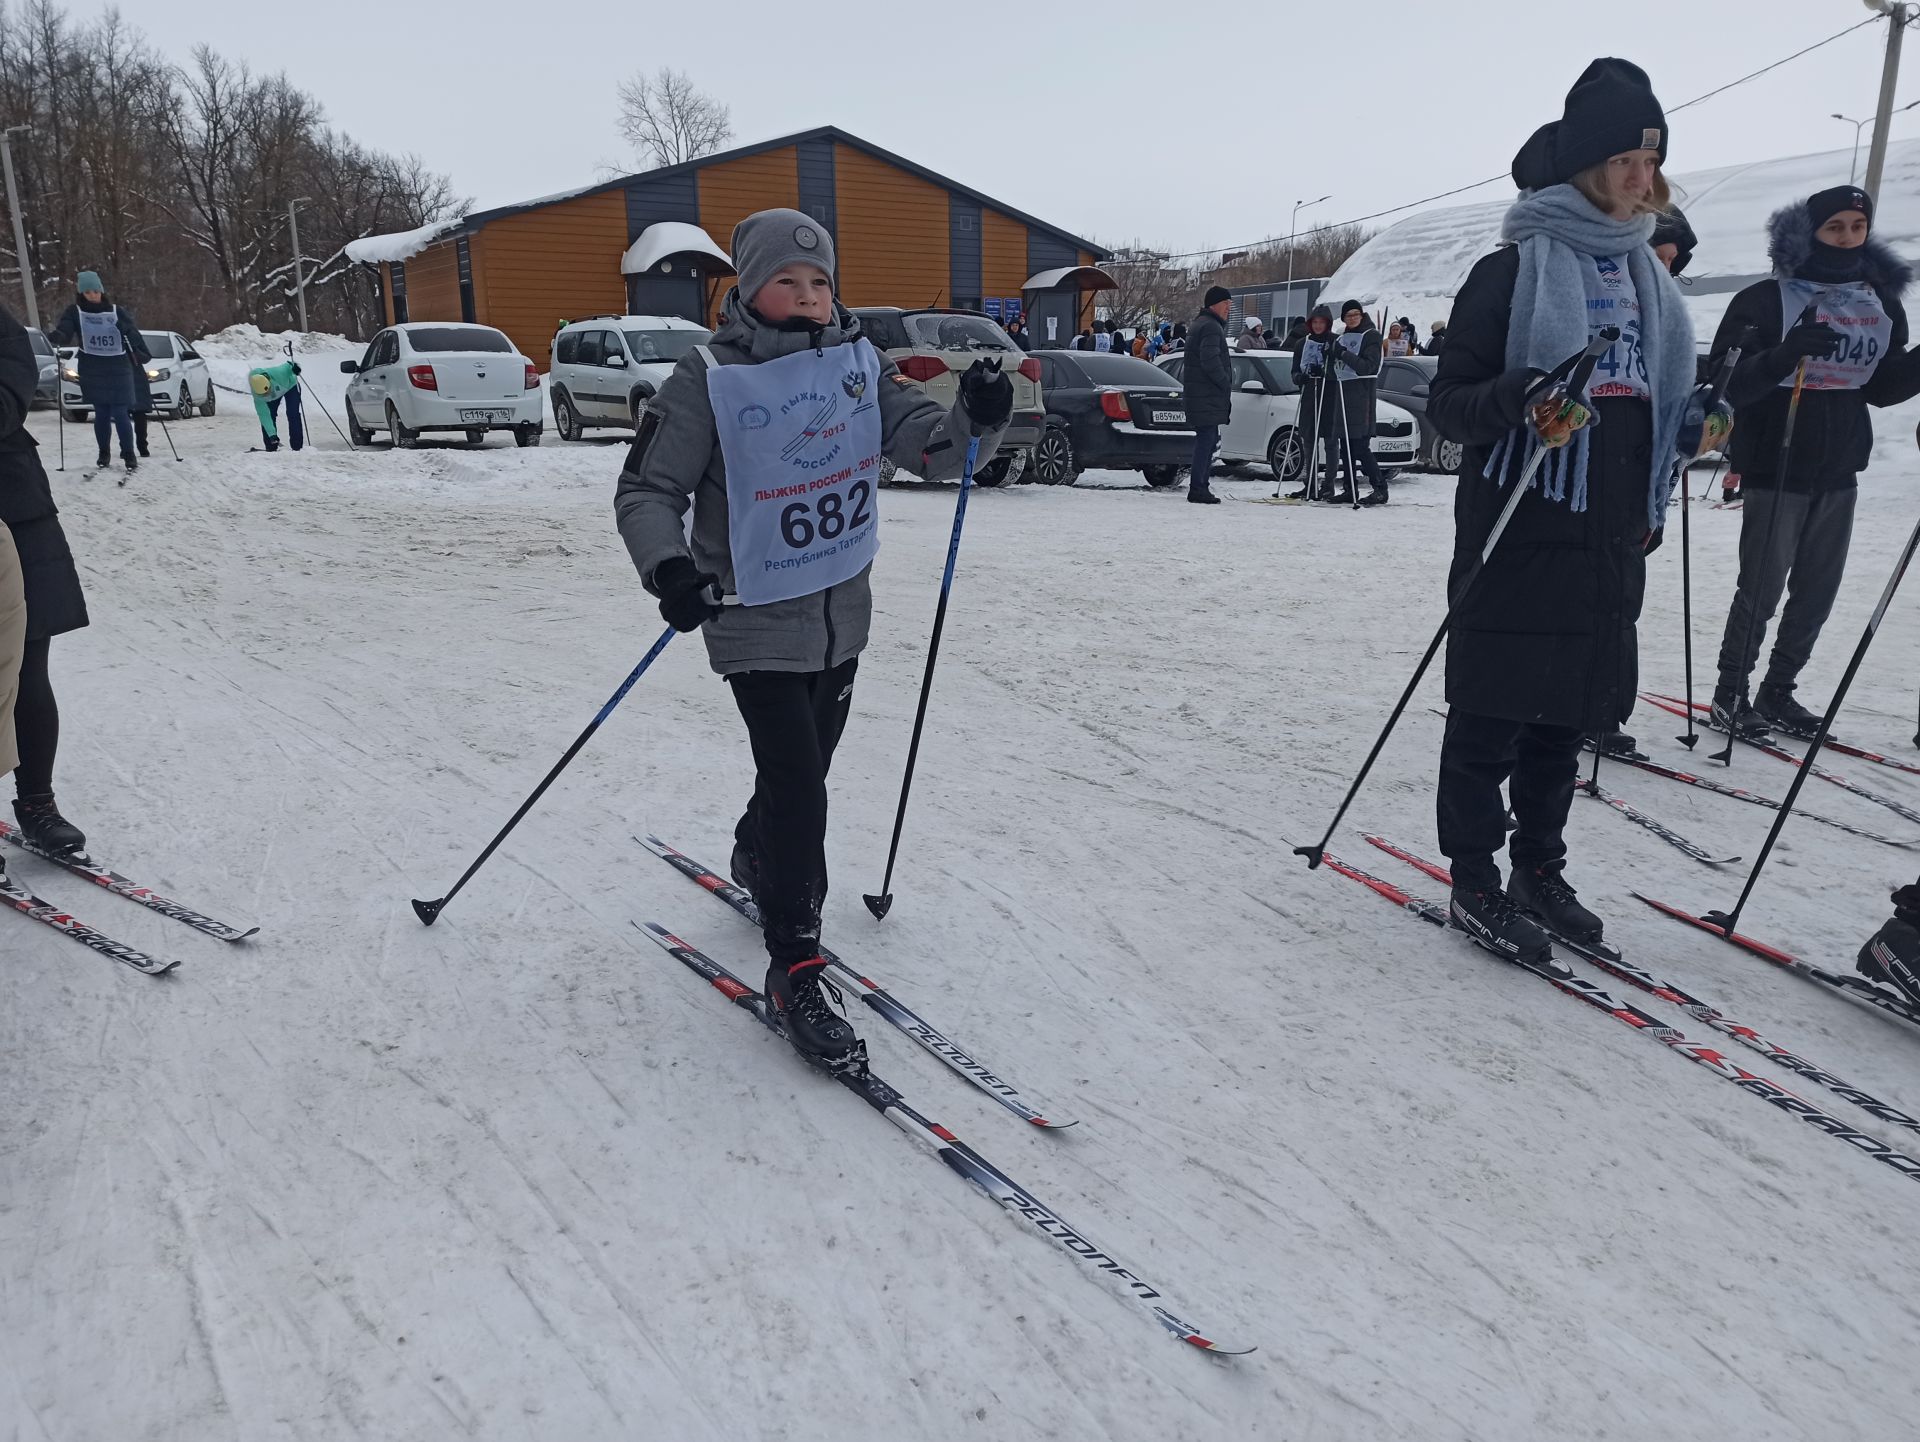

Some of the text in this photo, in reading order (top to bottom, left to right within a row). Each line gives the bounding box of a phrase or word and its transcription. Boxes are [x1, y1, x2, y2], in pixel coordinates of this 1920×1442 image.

[1586, 299, 1614, 309] ПРОМ
[90, 336, 115, 346] 4163
[780, 391, 827, 416] ЛЫЖНЯ
[822, 423, 847, 438] 2013
[793, 444, 841, 469] РОССИИ
[755, 484, 806, 501] ЛЫЖНЯ
[809, 466, 852, 491] РОССИИ
[780, 479, 870, 548] 682
[764, 546, 837, 571] Республика
[1451, 899, 1520, 954] SPINE
[681, 952, 721, 977] DELTA
[909, 1024, 1019, 1096] PELTONEN
[1002, 1192, 1161, 1299] PELTONEN
[1153, 1306, 1200, 1335] DELTA
